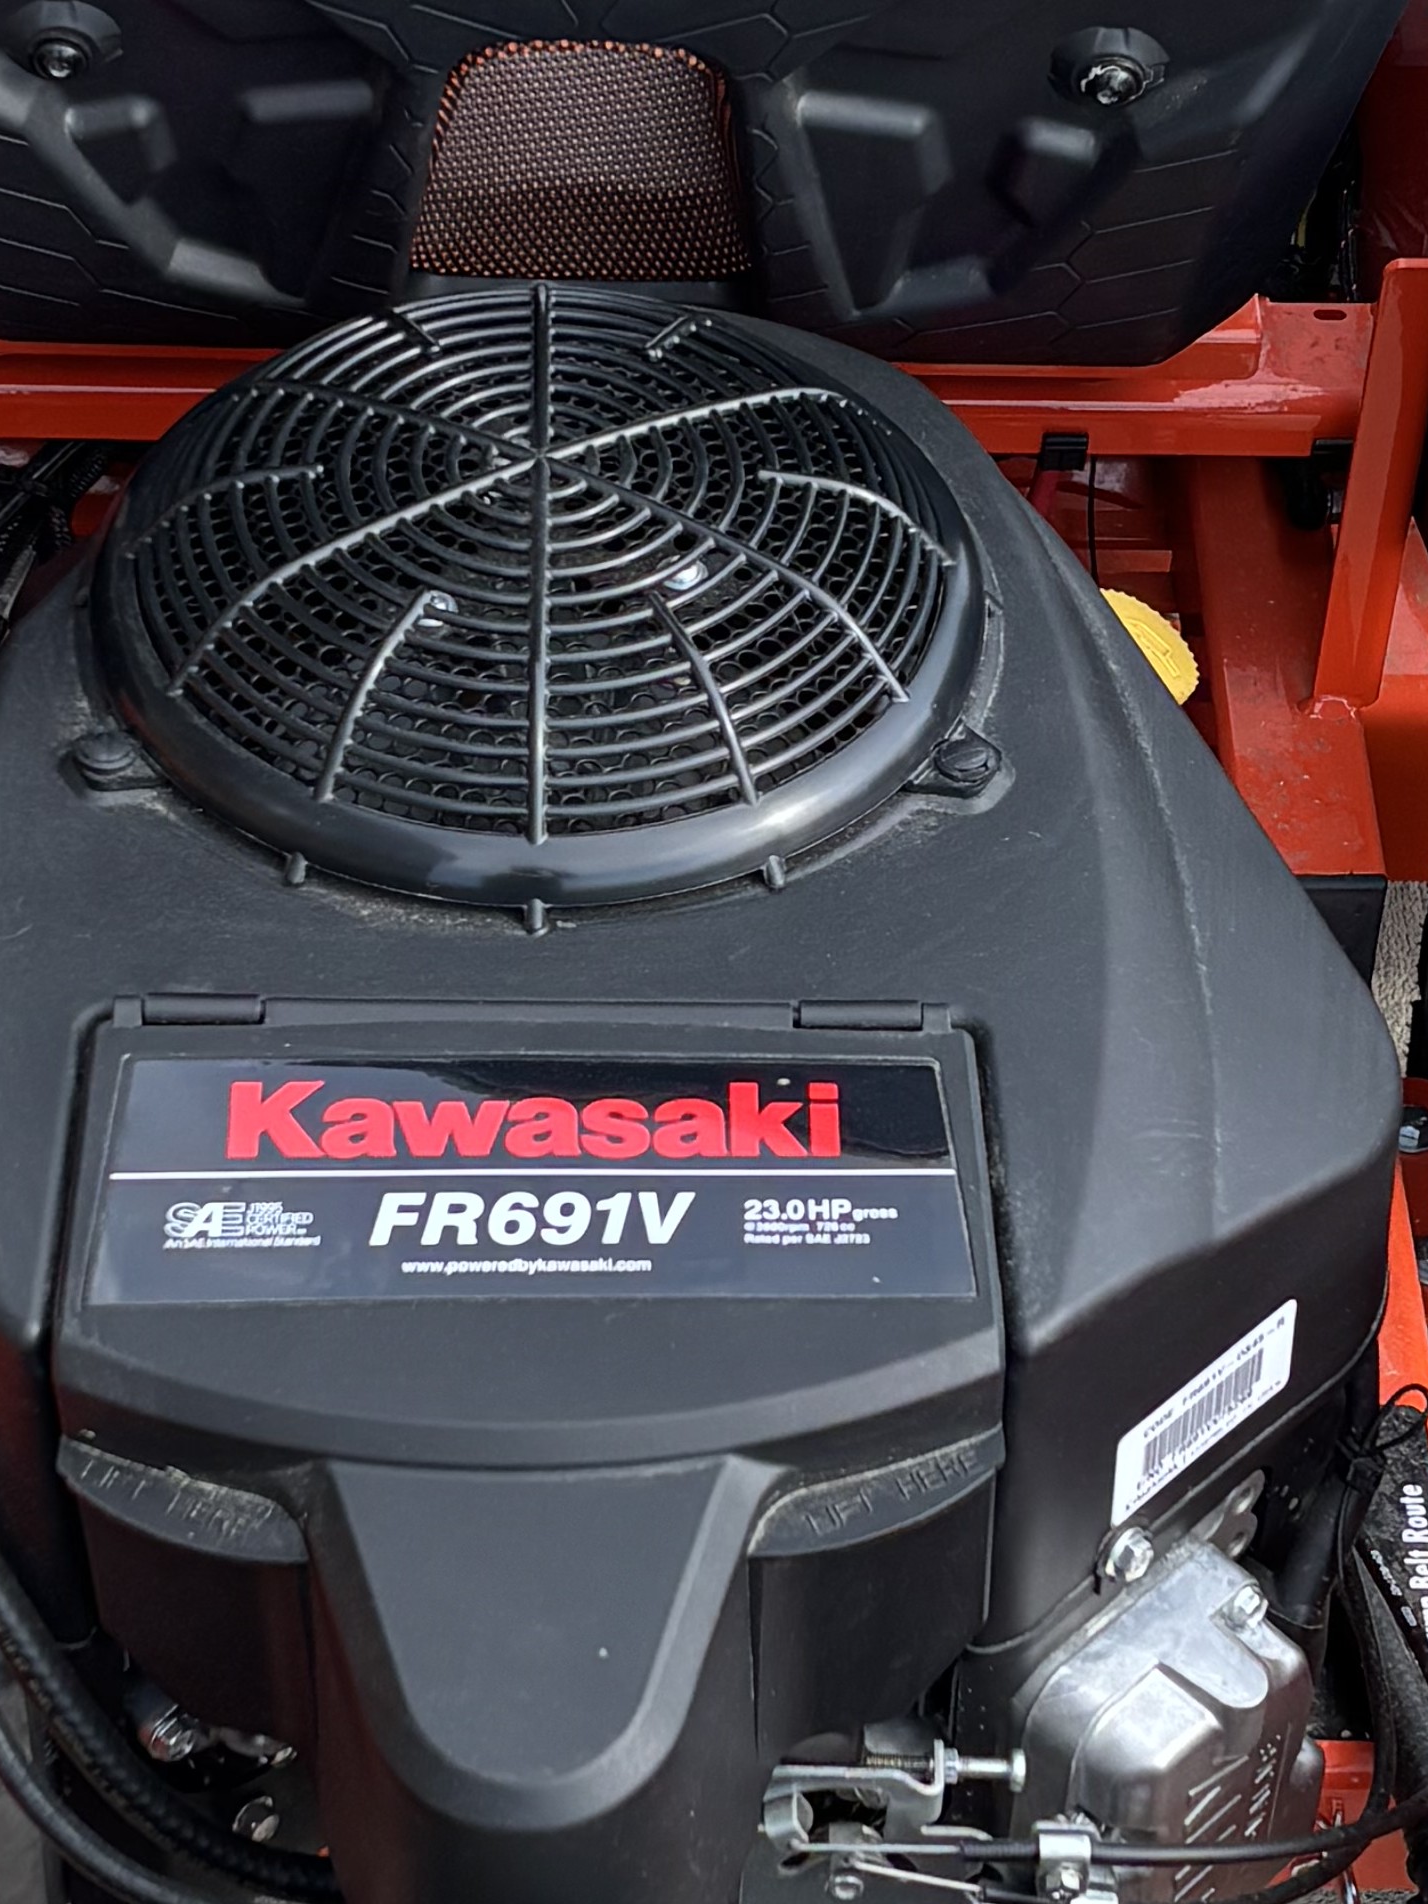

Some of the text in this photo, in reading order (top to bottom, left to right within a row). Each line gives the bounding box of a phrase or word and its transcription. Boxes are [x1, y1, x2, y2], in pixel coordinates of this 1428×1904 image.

[227, 1081, 841, 1159] Kawasaki
[246, 1212, 314, 1224] CERTIFIED
[368, 1191, 695, 1245] FR691V
[401, 1258, 652, 1276] www.poweredbykawasaki.com
